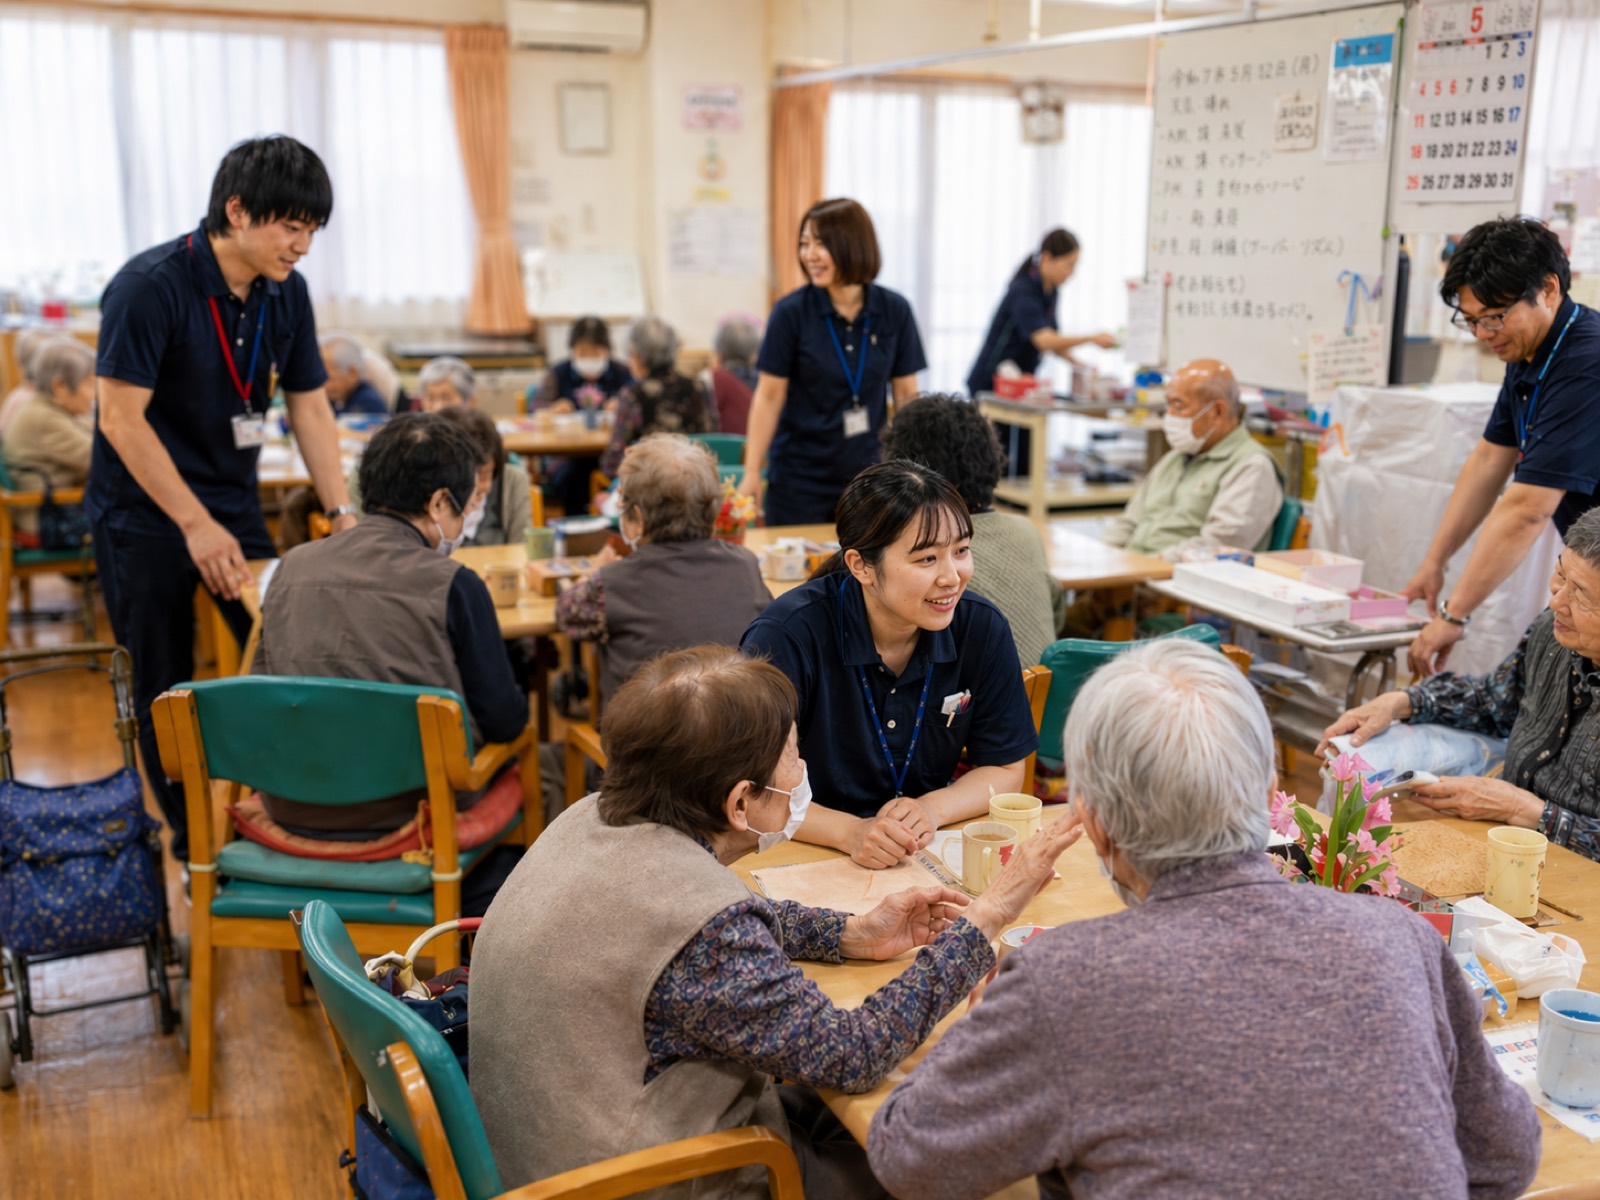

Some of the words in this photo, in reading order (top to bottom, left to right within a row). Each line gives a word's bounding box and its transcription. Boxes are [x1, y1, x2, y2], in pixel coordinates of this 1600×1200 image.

[1470, 6, 1483, 33] 5
[1486, 44, 1492, 59] 1
[1501, 42, 1509, 58] 2
[1517, 41, 1526, 57] 3
[1419, 82, 1426, 96] 4
[1434, 80, 1442, 96] 5
[1450, 79, 1457, 95] 6
[1466, 77, 1473, 93] 7
[1481, 76, 1489, 92] 8
[1498, 75, 1506, 91] 9
[1512, 74, 1525, 89] 10
[1414, 114, 1424, 127] 11
[1430, 113, 1441, 127] 12
[1445, 111, 1456, 126] 13
[1461, 110, 1472, 125] 14
[1476, 109, 1488, 124] 15
[1493, 107, 1504, 123] 16
[1509, 106, 1521, 122] 17
[1411, 145, 1422, 159] 18
[1427, 143, 1438, 159] 19
[1440, 143, 1453, 159] 20
[1456, 142, 1468, 158] 21
[1471, 141, 1484, 157] 22
[1487, 141, 1501, 157] 23
[1504, 139, 1517, 156] 24
[1406, 175, 1419, 190] 25
[1422, 175, 1434, 190] 26
[1437, 174, 1450, 190] 27
[1452, 174, 1465, 189] 28
[1468, 173, 1482, 189] 29
[1484, 173, 1497, 188] 30
[1501, 172, 1514, 188] 31
